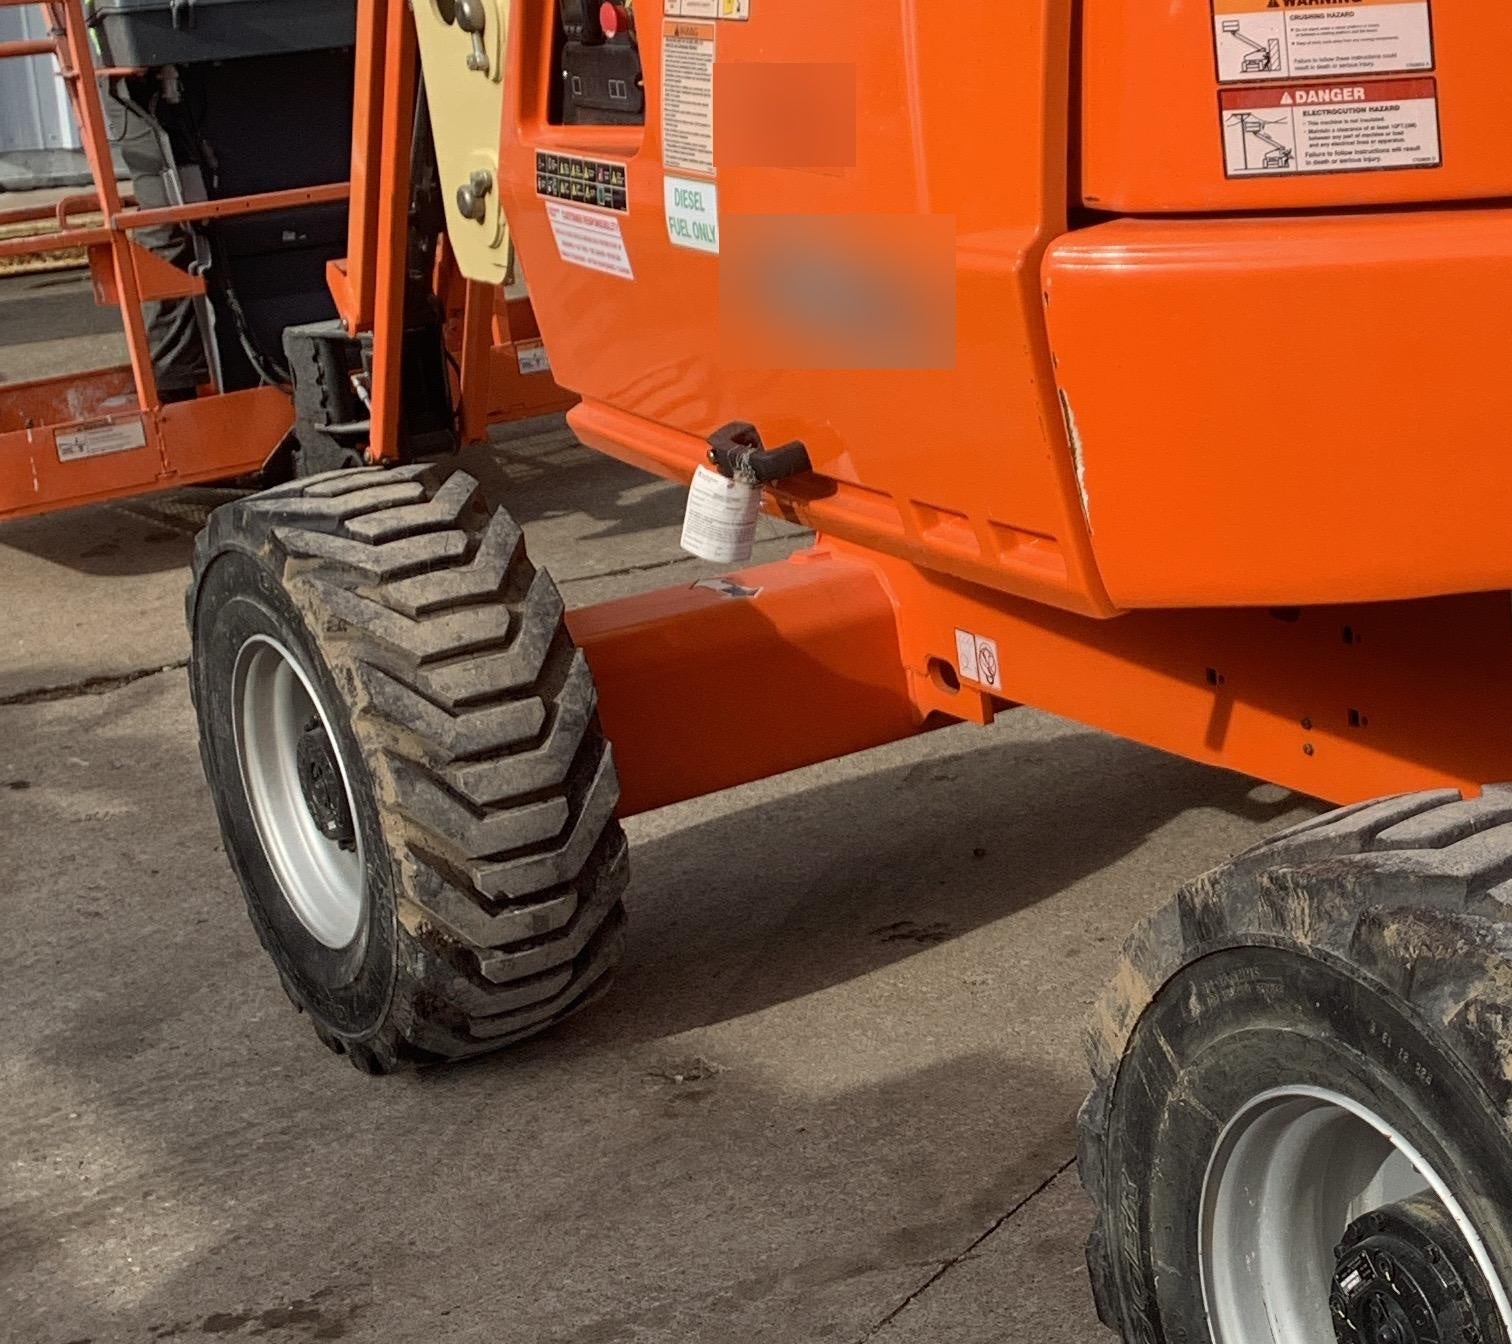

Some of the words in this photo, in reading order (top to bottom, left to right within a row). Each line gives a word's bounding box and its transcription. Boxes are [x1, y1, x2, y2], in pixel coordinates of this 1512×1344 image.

[1295, 87, 1365, 104] DANGER
[1302, 106, 1366, 116] ELECTROCUTION
[1368, 104, 1400, 113] HAZARD
[673, 187, 706, 212] DIESEL
[668, 216, 692, 238] FUEL
[692, 221, 716, 244] ONLY
